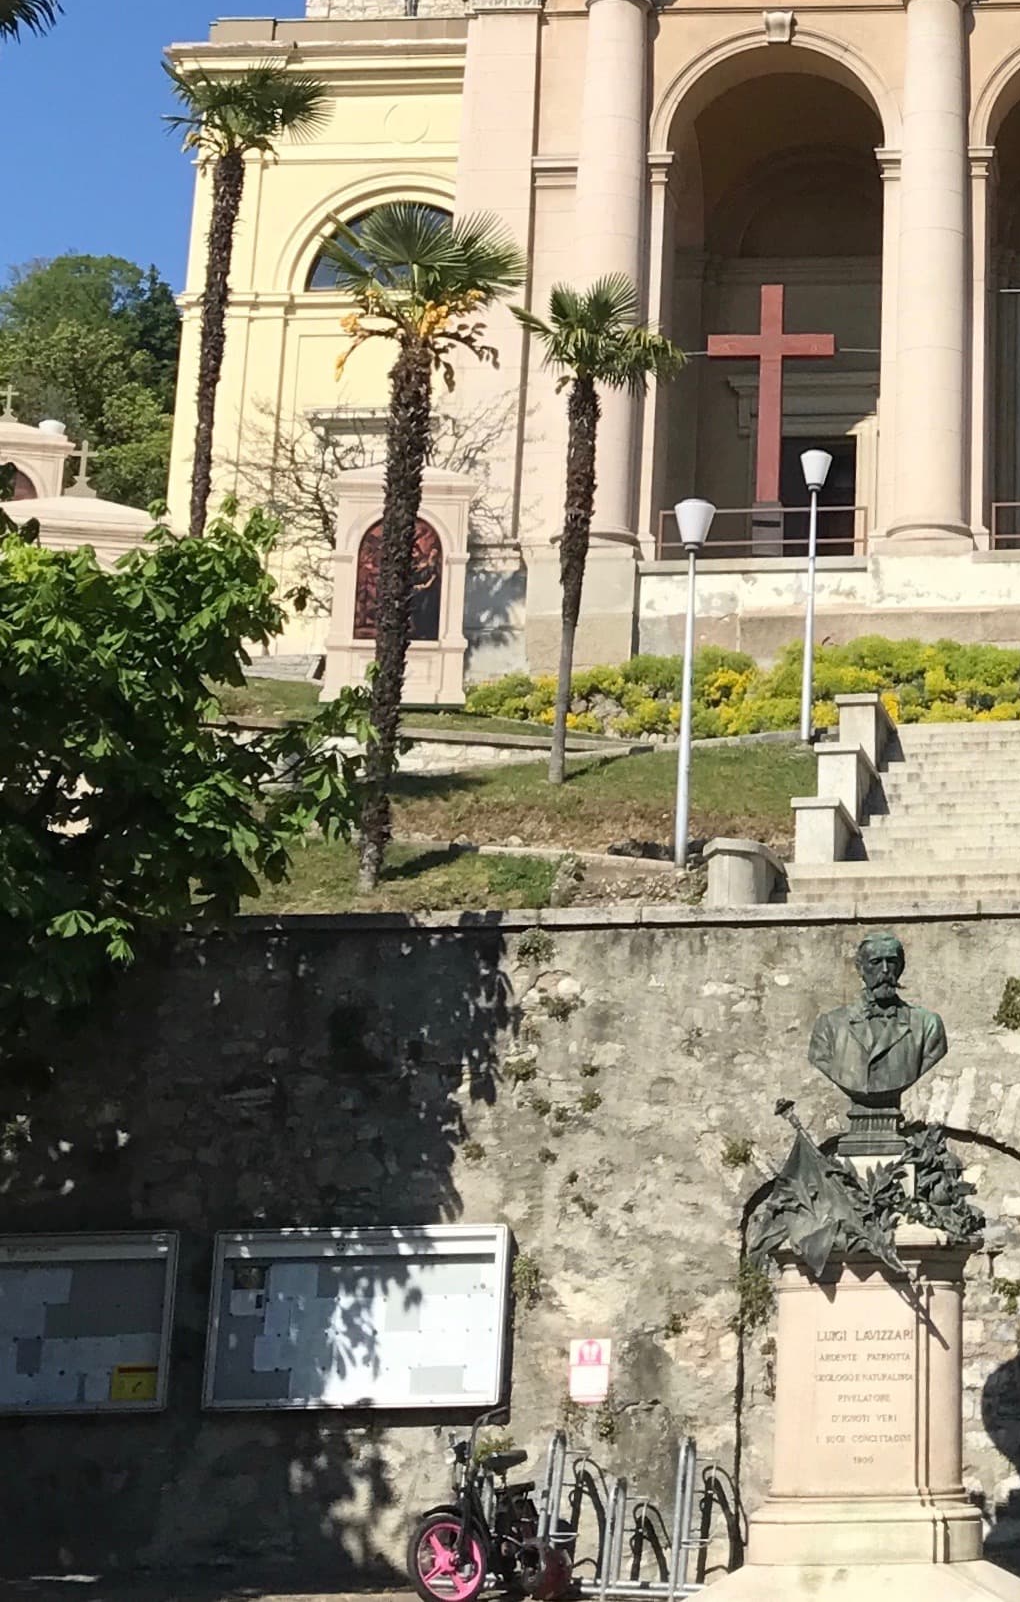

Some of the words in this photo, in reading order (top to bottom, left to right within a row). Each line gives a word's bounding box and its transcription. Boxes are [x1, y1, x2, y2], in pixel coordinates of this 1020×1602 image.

[816, 1330, 847, 1342] LUIGI
[855, 1329, 914, 1341] LAVIZZARI
[818, 1353, 857, 1362] ARDENTE
[866, 1352, 911, 1361] PATRIOTTA
[815, 1373, 854, 1382] GEOLOGO
[854, 1373, 860, 1382] E
[862, 1373, 913, 1382] NATURALISTA
[837, 1393, 891, 1403] RIVELATORE
[876, 1414, 897, 1423] VERI
